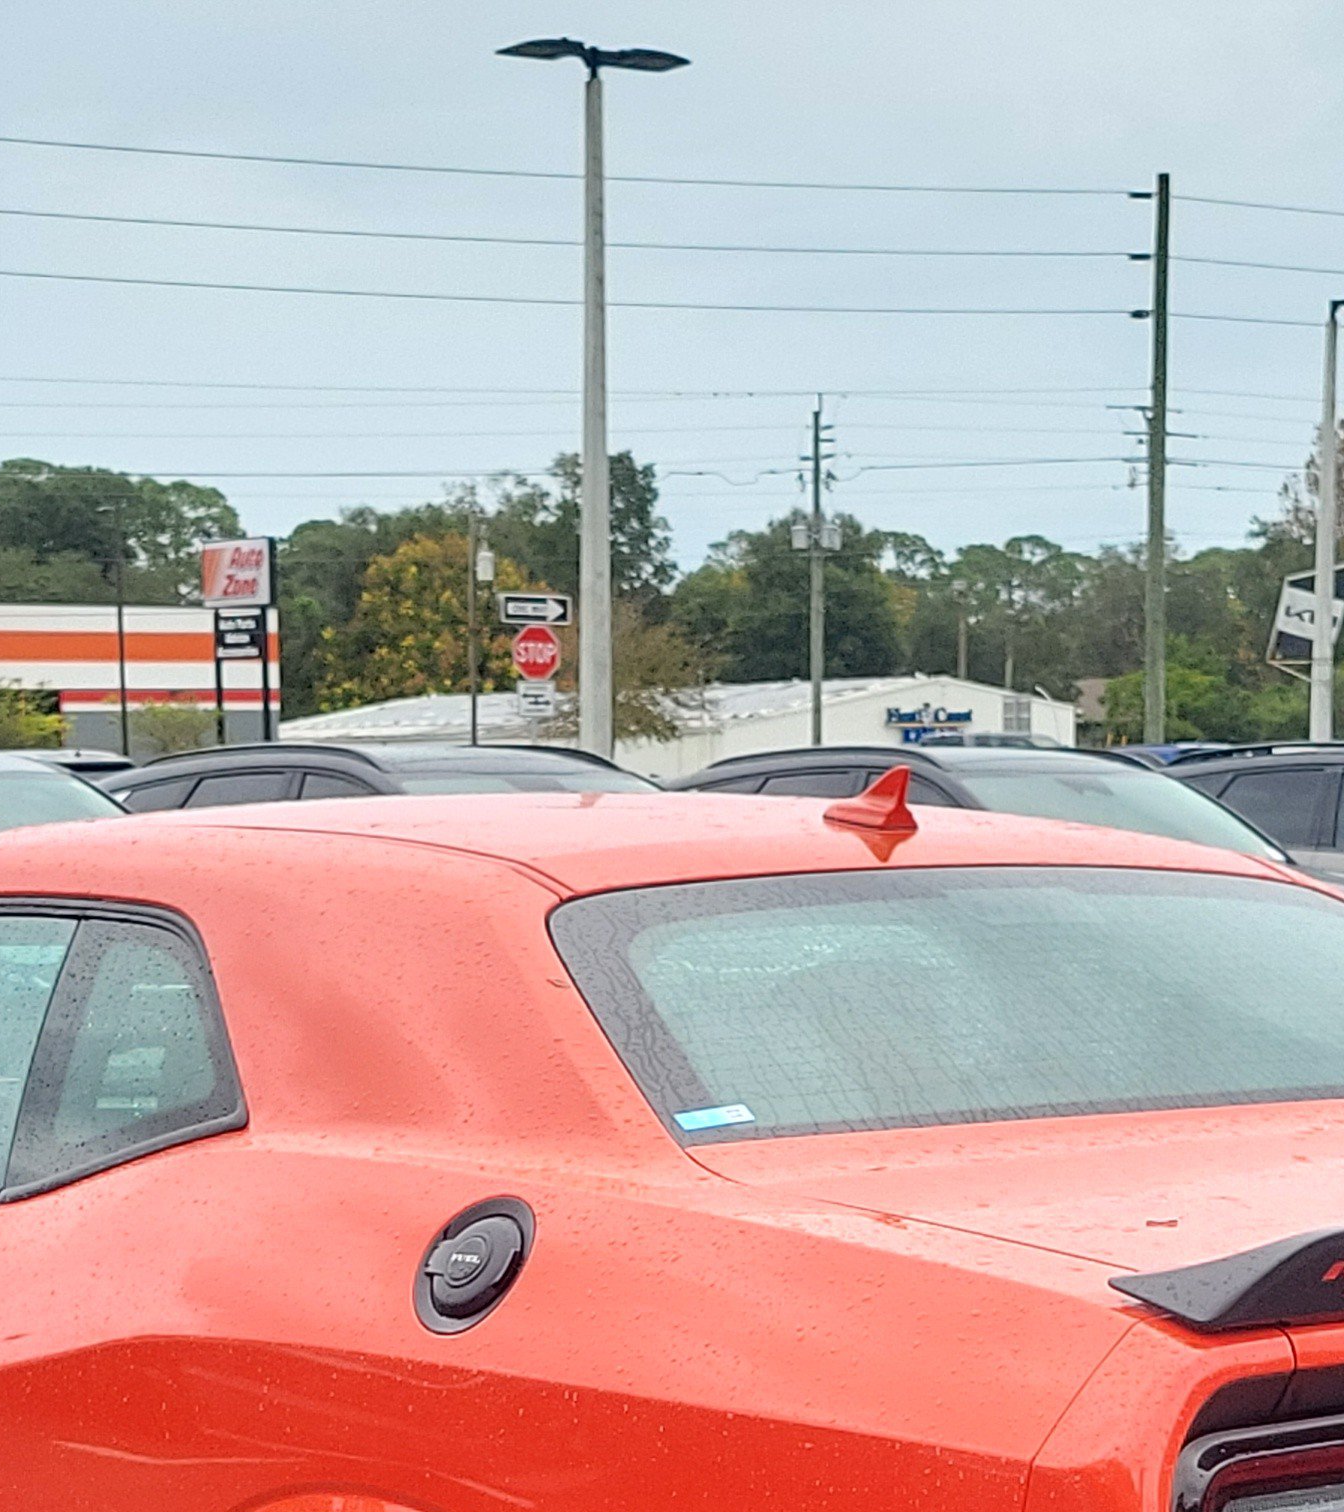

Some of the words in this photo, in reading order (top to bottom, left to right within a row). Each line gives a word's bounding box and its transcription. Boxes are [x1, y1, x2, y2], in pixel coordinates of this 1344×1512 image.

[231, 547, 263, 569] Auto
[223, 574, 258, 597] Zone
[517, 642, 556, 664] STOP
